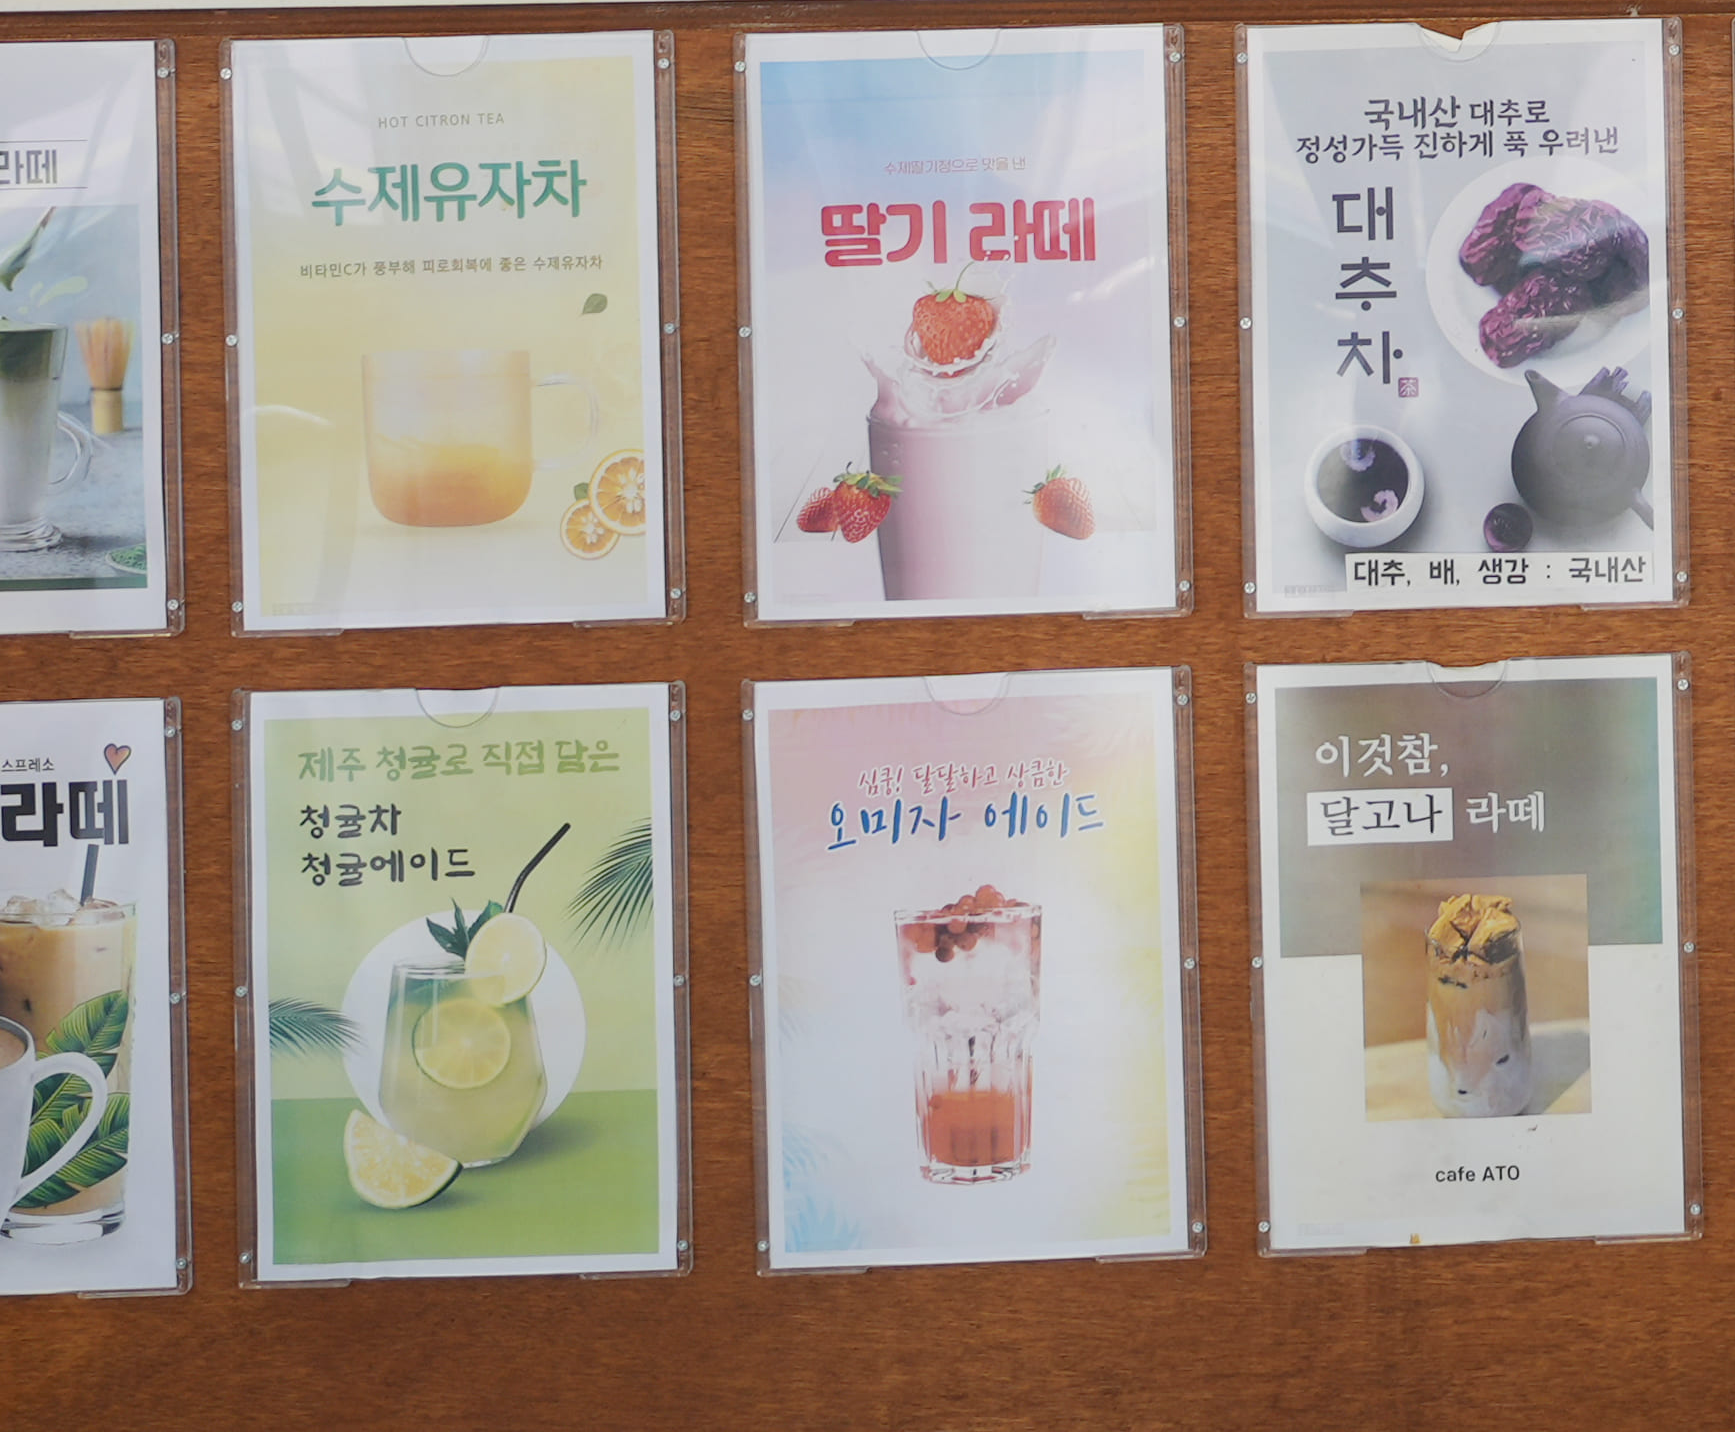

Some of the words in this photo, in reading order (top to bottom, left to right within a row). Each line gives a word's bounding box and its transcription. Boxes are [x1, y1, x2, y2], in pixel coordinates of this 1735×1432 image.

[378, 115, 409, 129] HOT
[415, 113, 471, 128] CITRON
[477, 112, 505, 126] TEA
[1364, 95, 1461, 130] 국내산
[1470, 98, 1550, 125] 대추로
[311, 158, 587, 227] 수제유자차
[821, 199, 948, 267] 딸기
[969, 197, 1096, 263] 라떼
[1353, 557, 1412, 588] 대추,
[1429, 560, 1460, 586] 배,
[1477, 557, 1529, 585] 생강
[1568, 555, 1645, 584] 국내산
[1315, 732, 1449, 779] 이것참,
[0, 779, 129, 847] 라떼
[299, 803, 402, 839] 청귤차
[827, 799, 962, 851] 오미자
[984, 791, 1104, 838] 에이드
[1321, 794, 1443, 836] 달고나
[1465, 791, 1546, 833] 라떼
[300, 847, 476, 887] 청귤에이드
[1435, 1167, 1476, 1183] cafe
[1482, 1166, 1520, 1182] ATO
